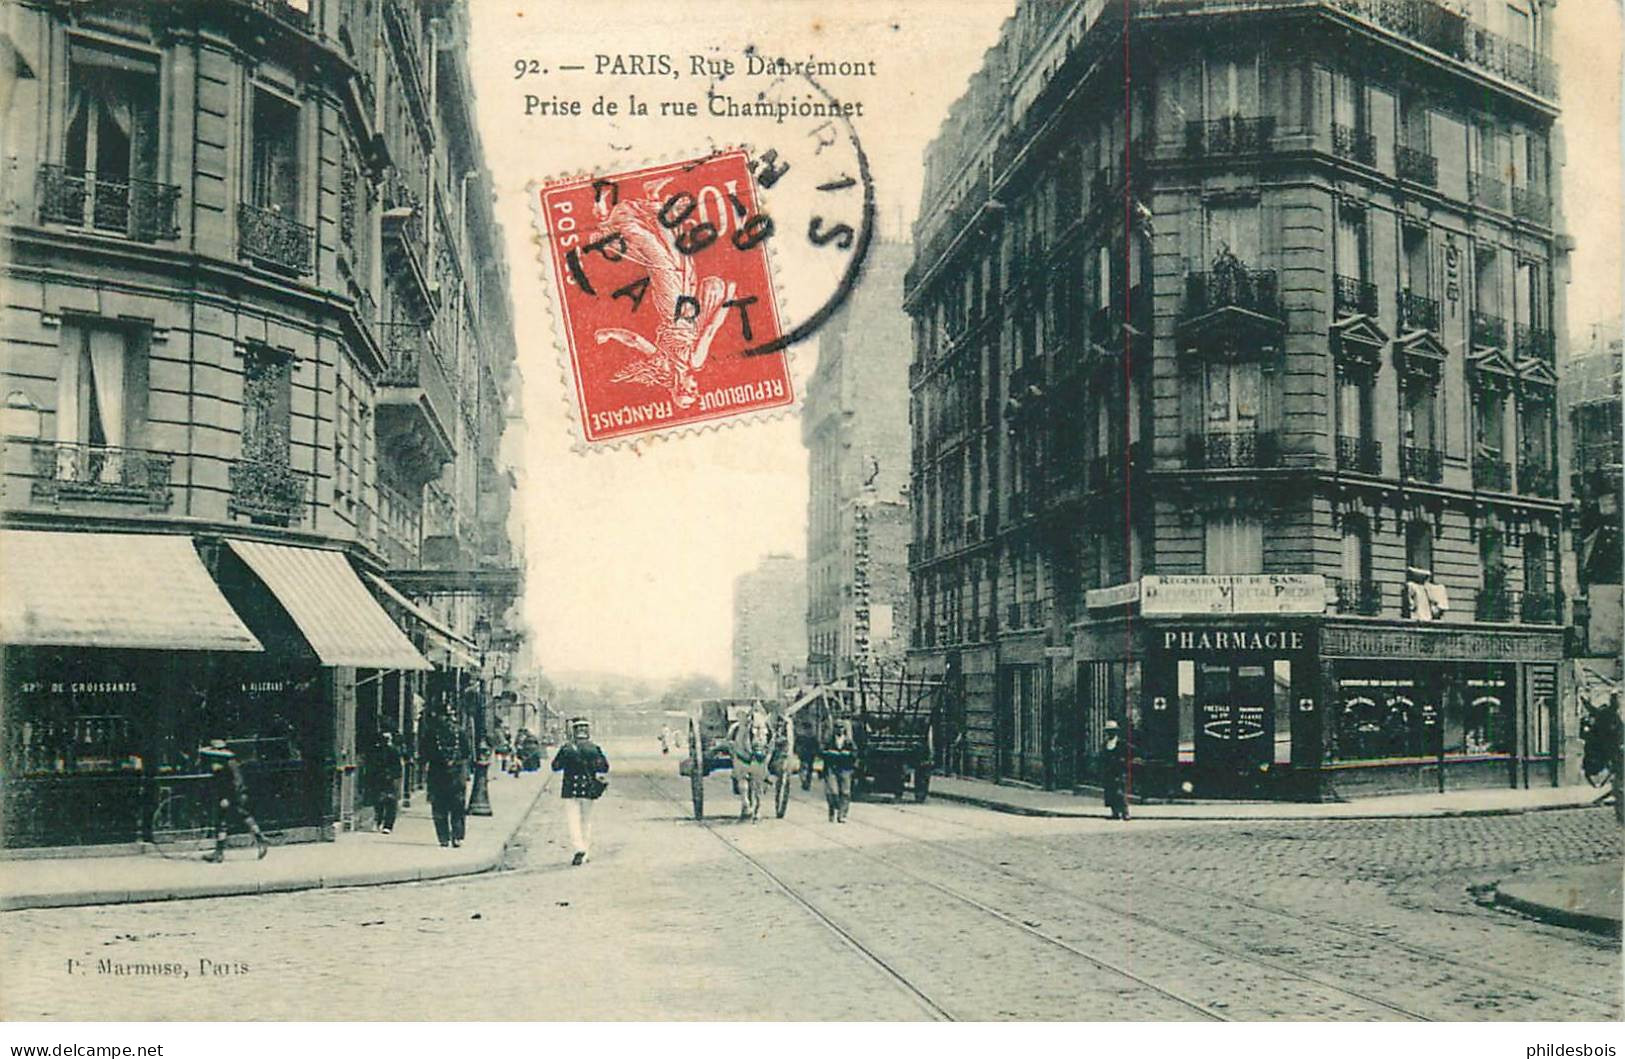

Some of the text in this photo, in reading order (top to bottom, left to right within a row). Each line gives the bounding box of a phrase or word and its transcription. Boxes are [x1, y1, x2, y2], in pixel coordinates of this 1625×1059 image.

[553, 201, 580, 285] POSS
[1164, 632, 1303, 649] PHARMACIE
[71, 682, 137, 693] CROISSANTS
